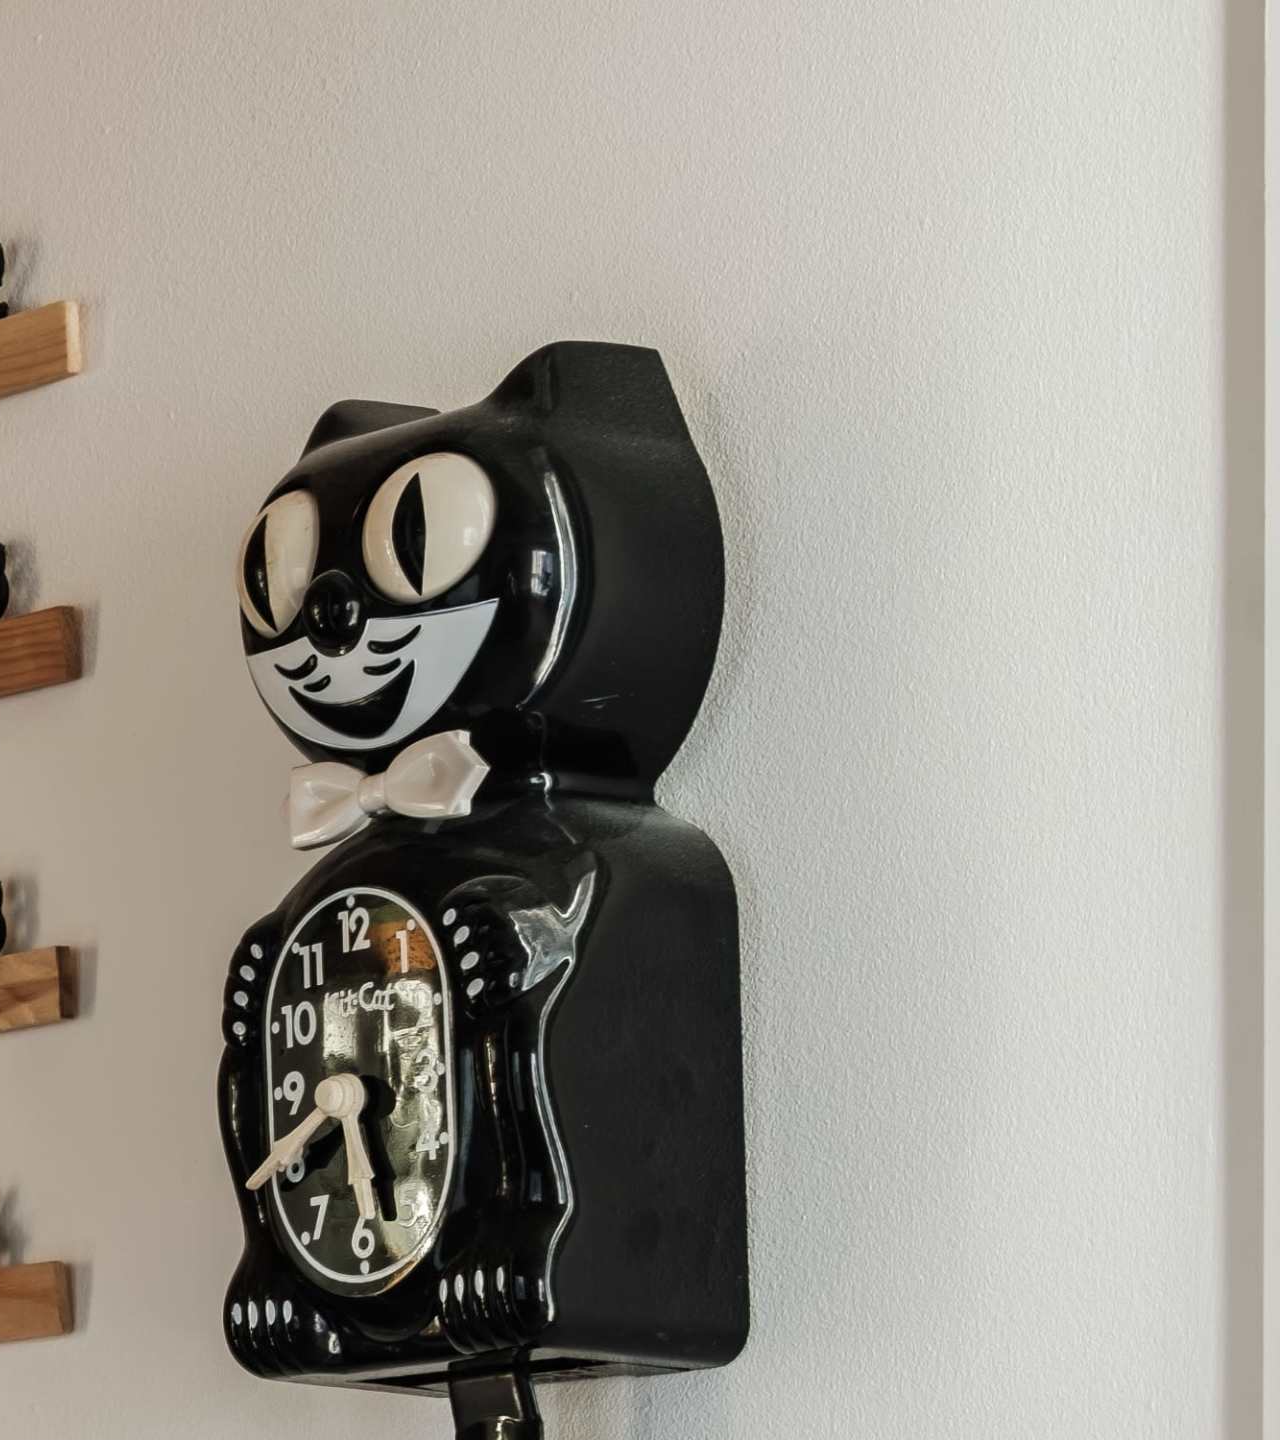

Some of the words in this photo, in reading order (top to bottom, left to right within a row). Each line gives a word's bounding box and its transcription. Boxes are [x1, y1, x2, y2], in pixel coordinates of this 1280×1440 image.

[338, 907, 371, 954] 12
[395, 929, 409, 974] 1
[298, 943, 324, 989] 11
[281, 1001, 317, 1048] 10
[283, 1071, 305, 1116] 9
[309, 1195, 329, 1240] 7
[351, 1215, 375, 1259] 6
